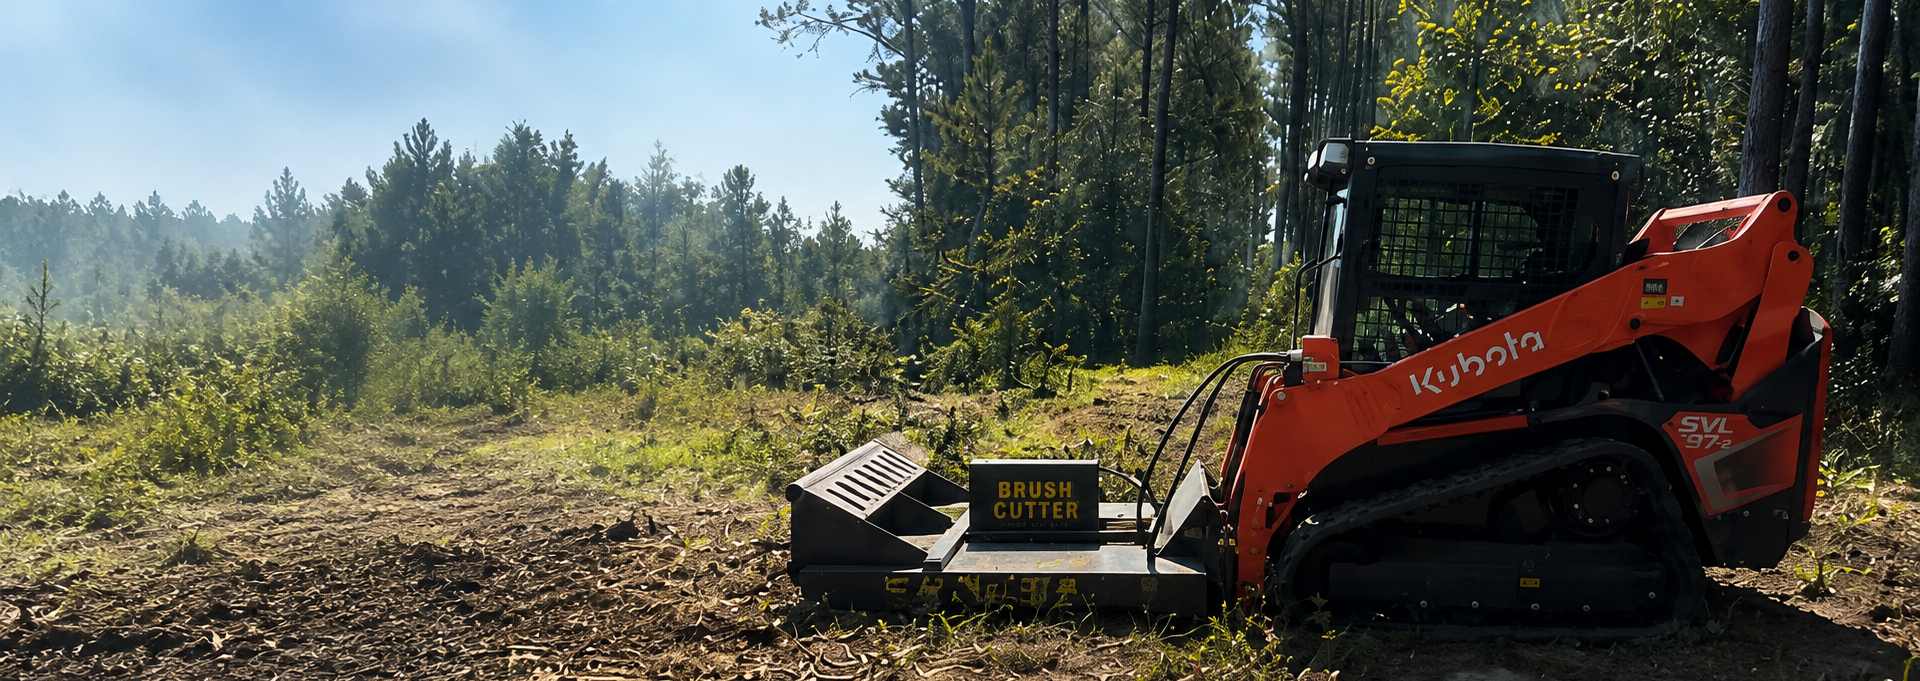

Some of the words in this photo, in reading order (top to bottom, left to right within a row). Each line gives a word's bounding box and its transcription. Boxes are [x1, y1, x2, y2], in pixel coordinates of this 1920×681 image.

[1409, 331, 1545, 395] Kubota
[1678, 416, 1733, 434] SVL
[998, 481, 1072, 498] BRUSH
[993, 501, 1078, 519] CUTTER
